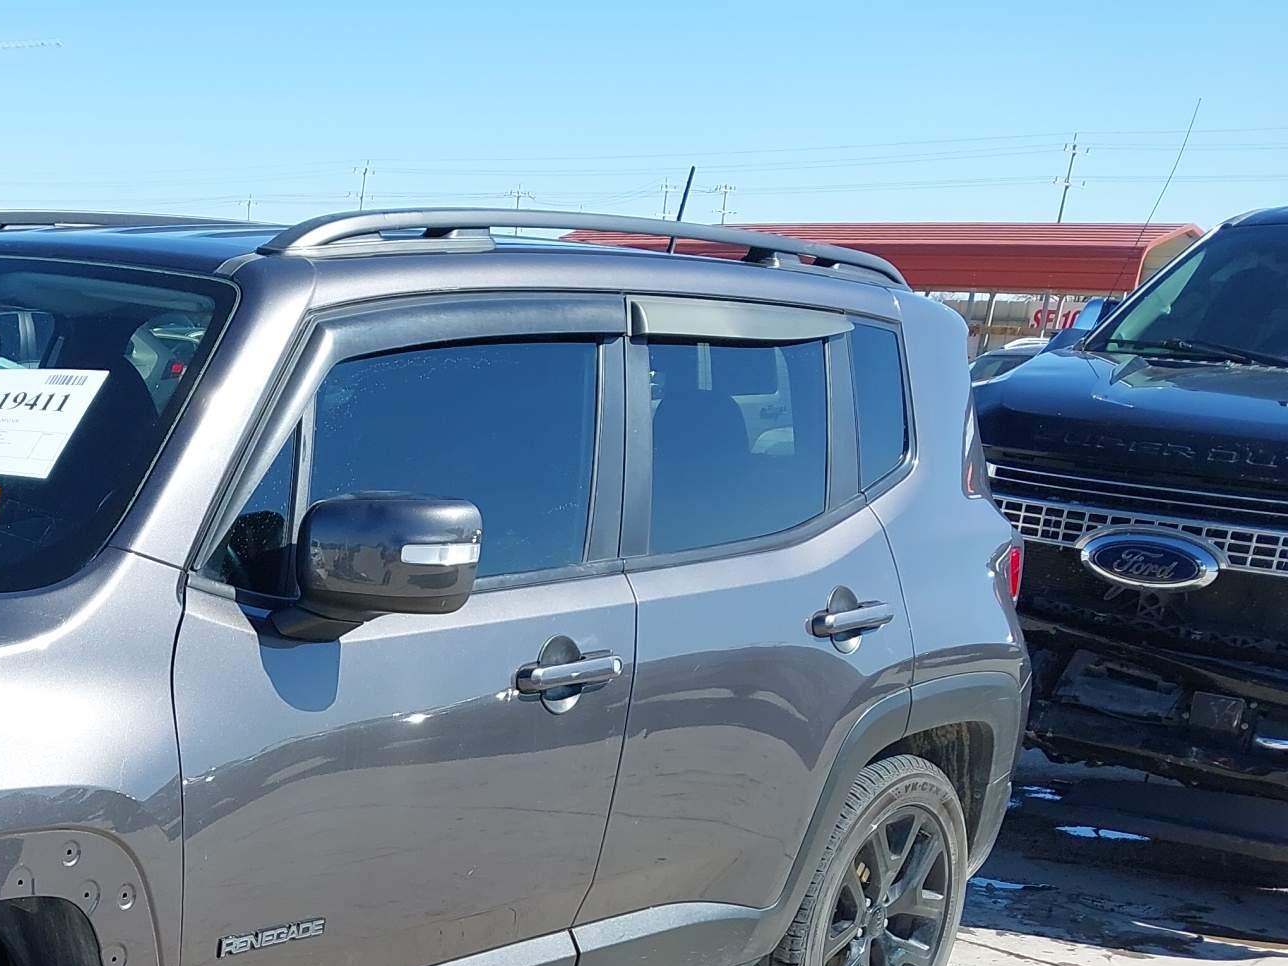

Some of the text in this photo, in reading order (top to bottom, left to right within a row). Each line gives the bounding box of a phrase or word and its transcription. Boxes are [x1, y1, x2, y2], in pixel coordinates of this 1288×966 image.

[1034, 432, 1197, 460] UPER
[1112, 548, 1180, 579] Ford
[215, 917, 327, 959] RENEGADE
